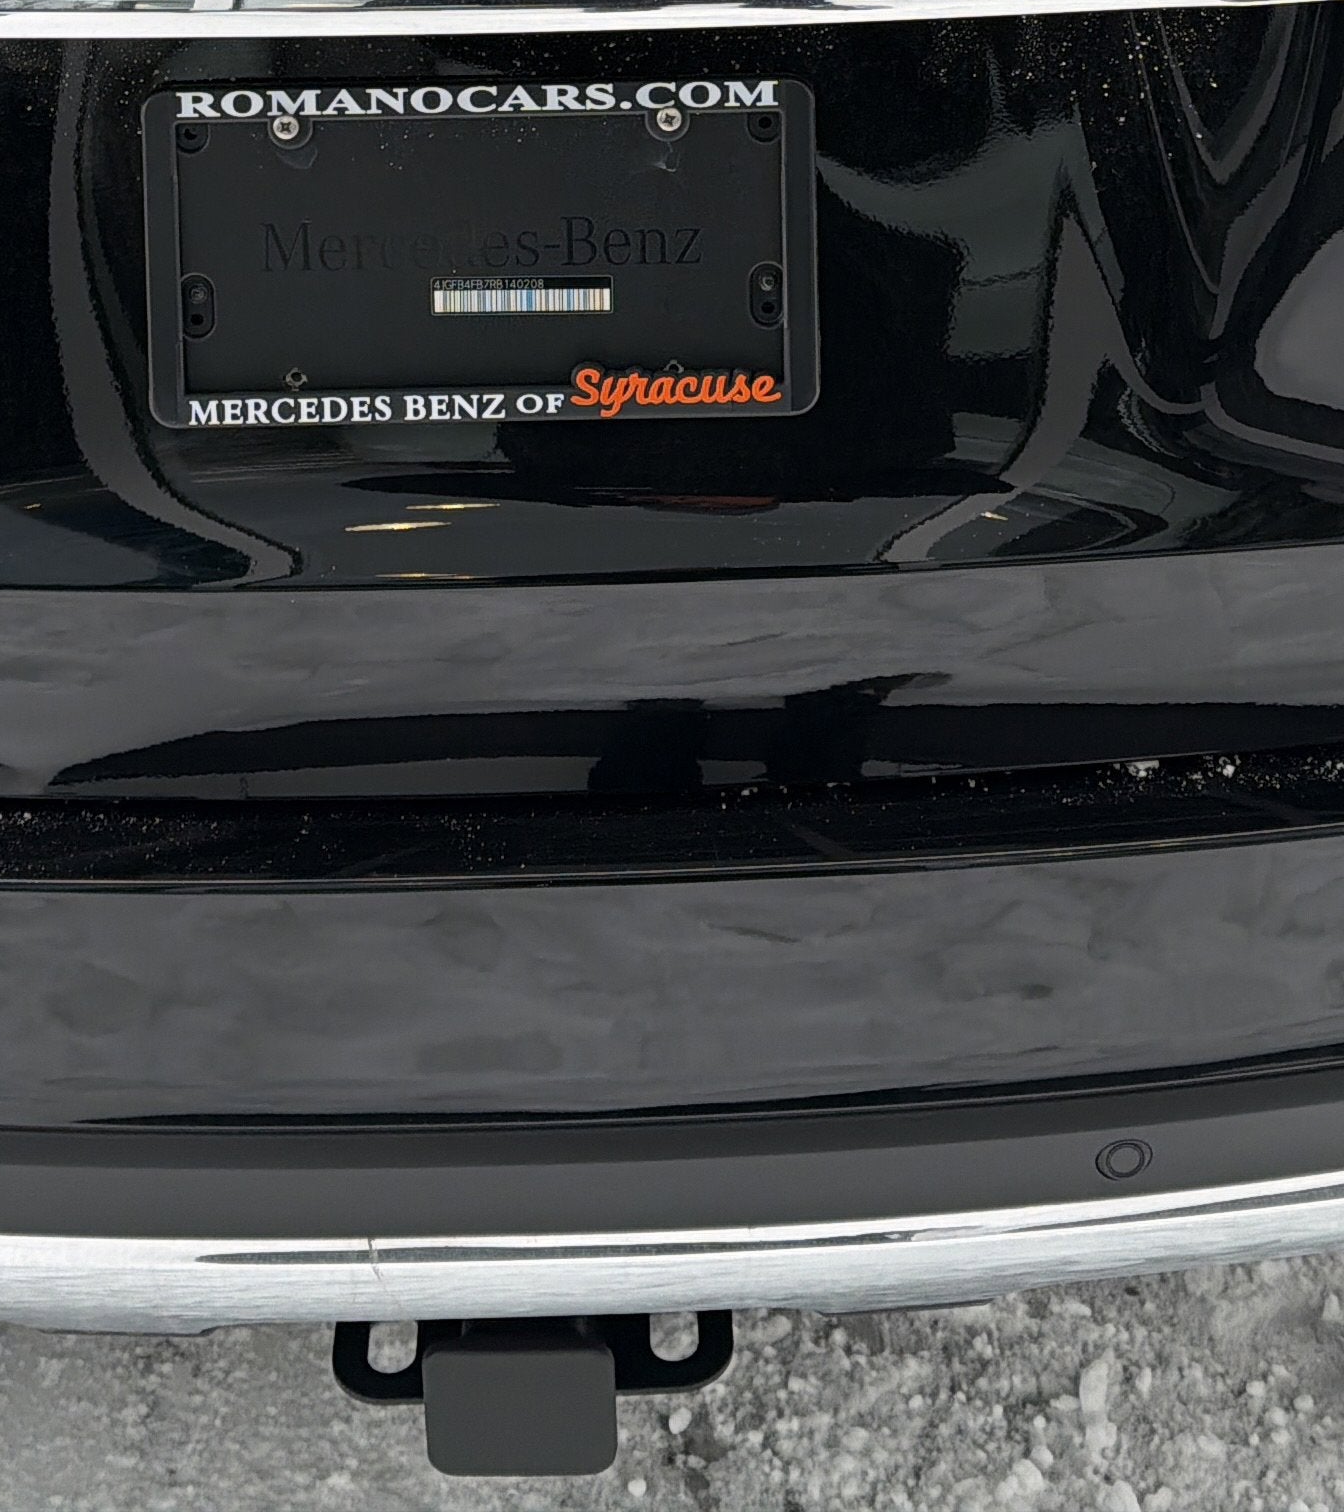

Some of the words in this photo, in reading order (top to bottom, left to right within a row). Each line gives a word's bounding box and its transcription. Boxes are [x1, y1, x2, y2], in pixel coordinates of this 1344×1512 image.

[175, 80, 780, 119] ROMANOCARS.COM
[433, 278, 545, 290] 4JGFB4FB7RB140208
[188, 394, 392, 426] MERCEDES
[403, 393, 507, 421] BENZ
[516, 392, 565, 415] OF
[570, 368, 782, 418] Syracuse
